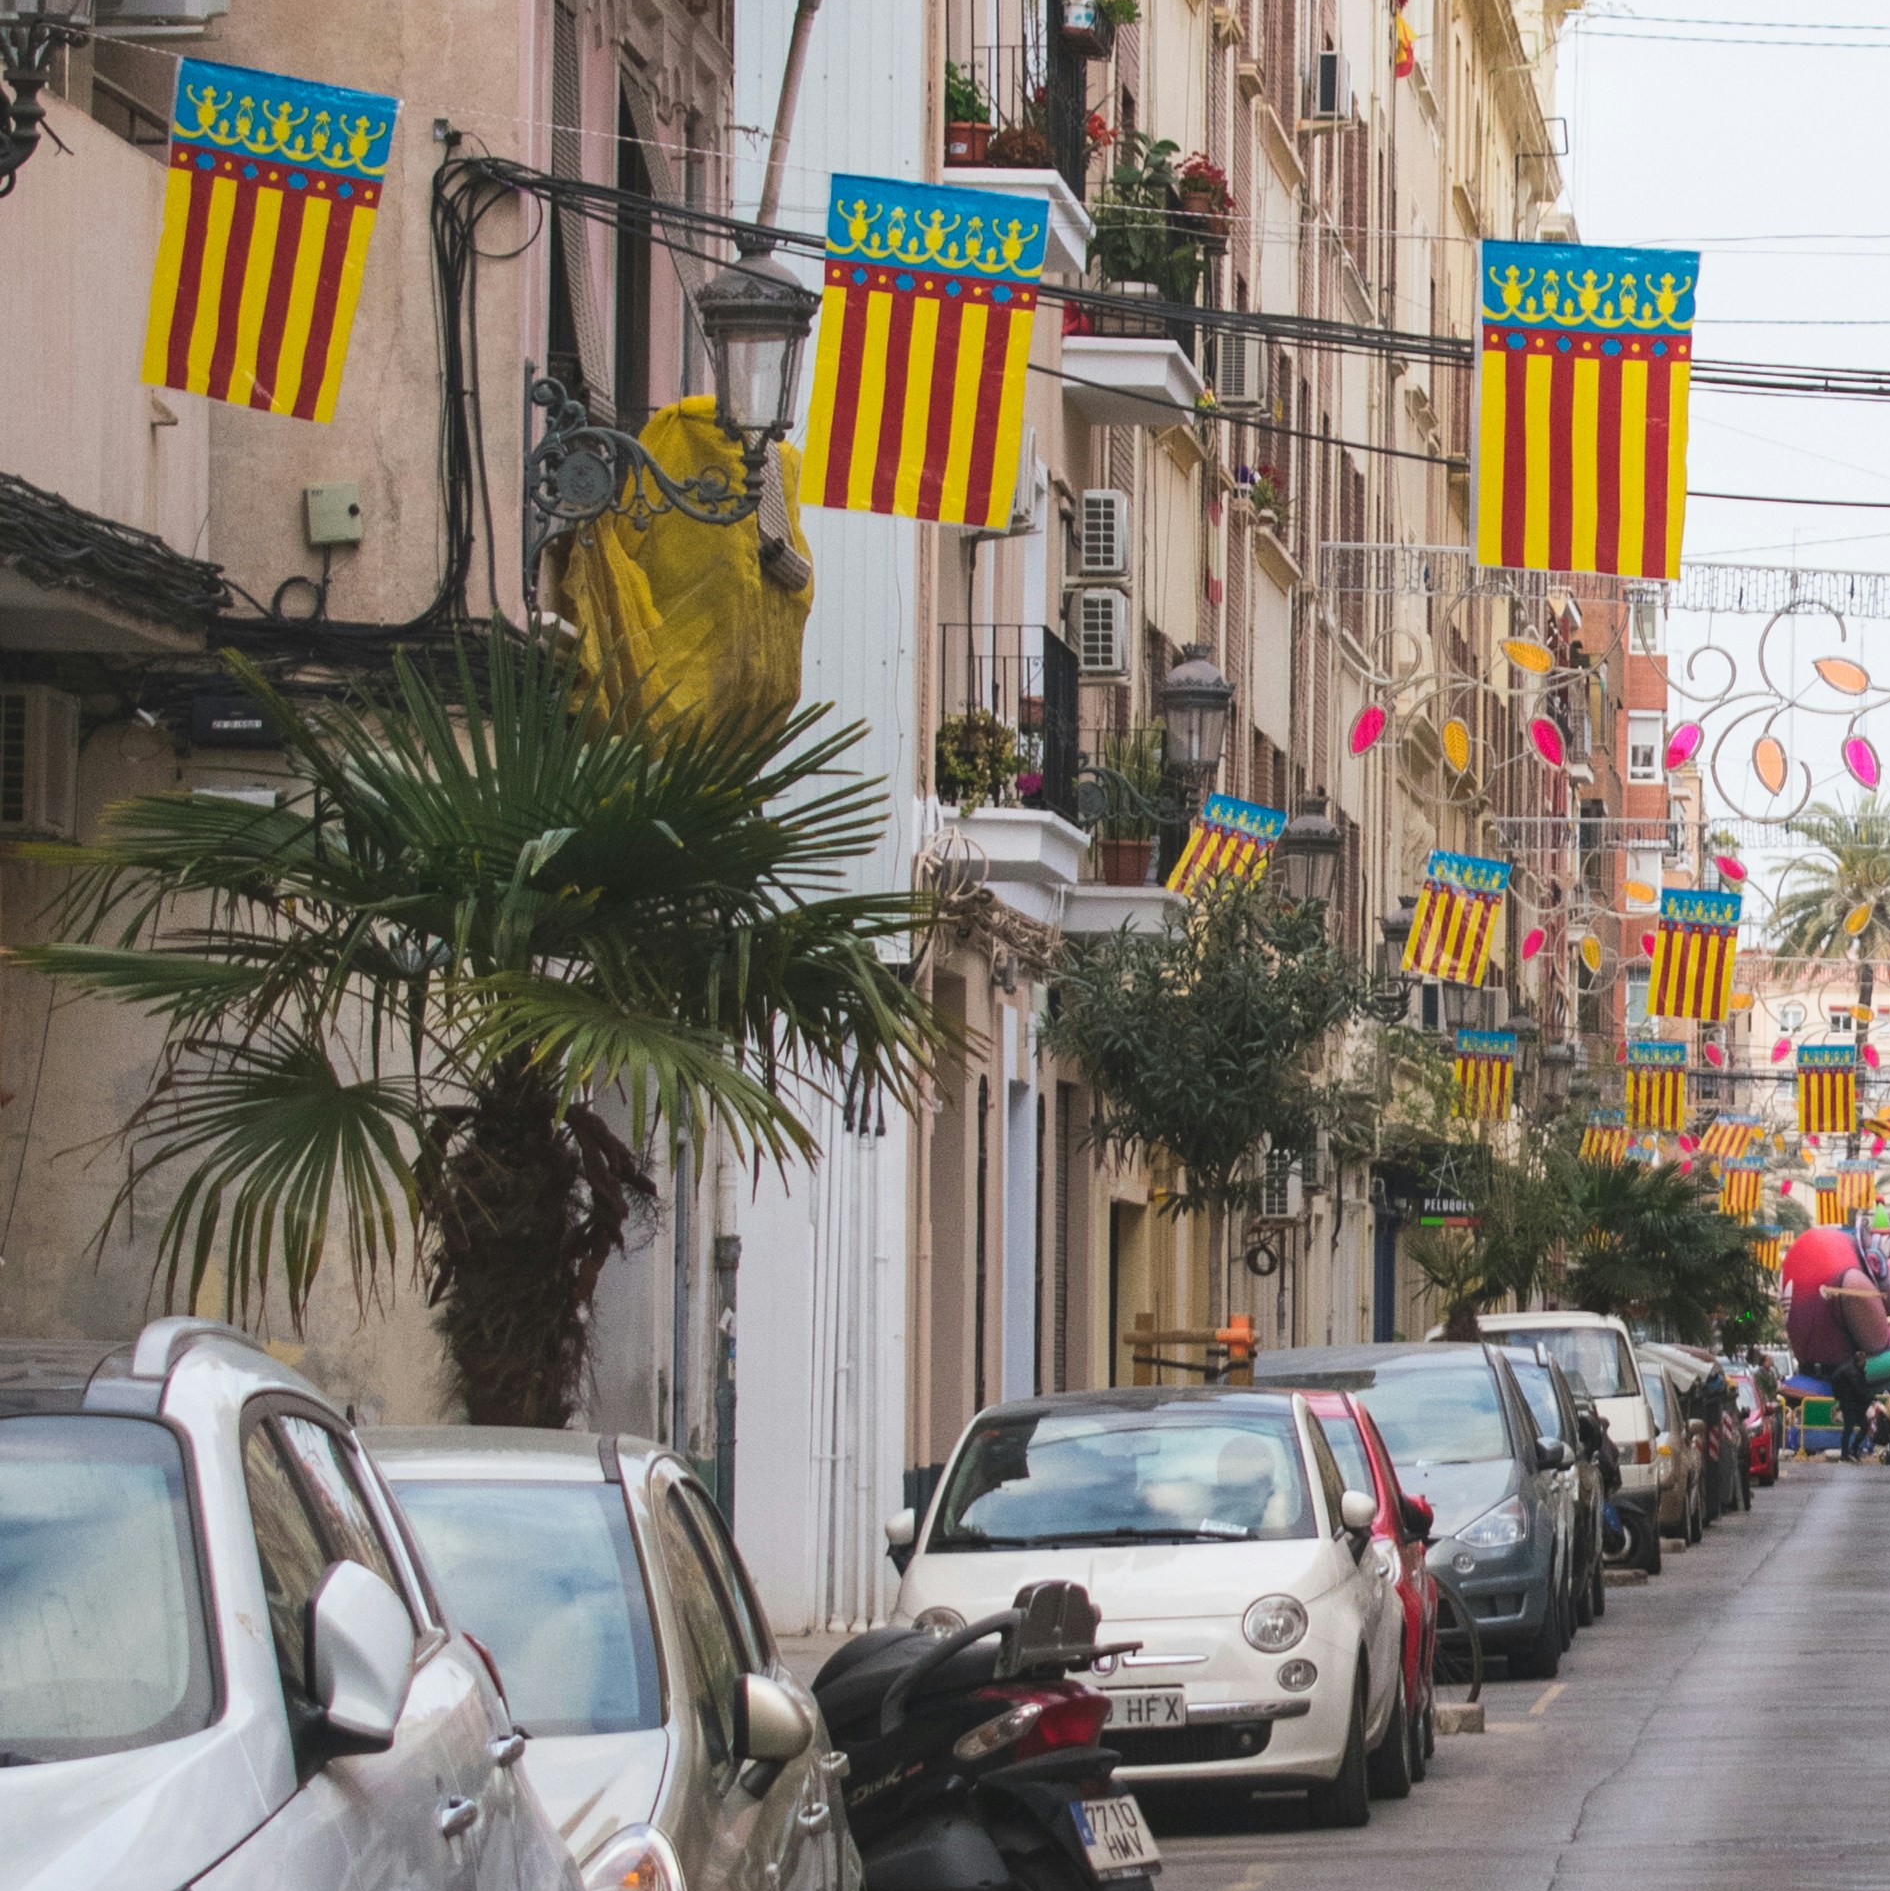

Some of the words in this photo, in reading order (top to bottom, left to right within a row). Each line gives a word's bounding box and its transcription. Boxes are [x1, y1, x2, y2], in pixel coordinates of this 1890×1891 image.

[1127, 1697, 1179, 1723] HFX
[1084, 1802, 1138, 1834] 7710
[1104, 1830, 1144, 1861] HMV
